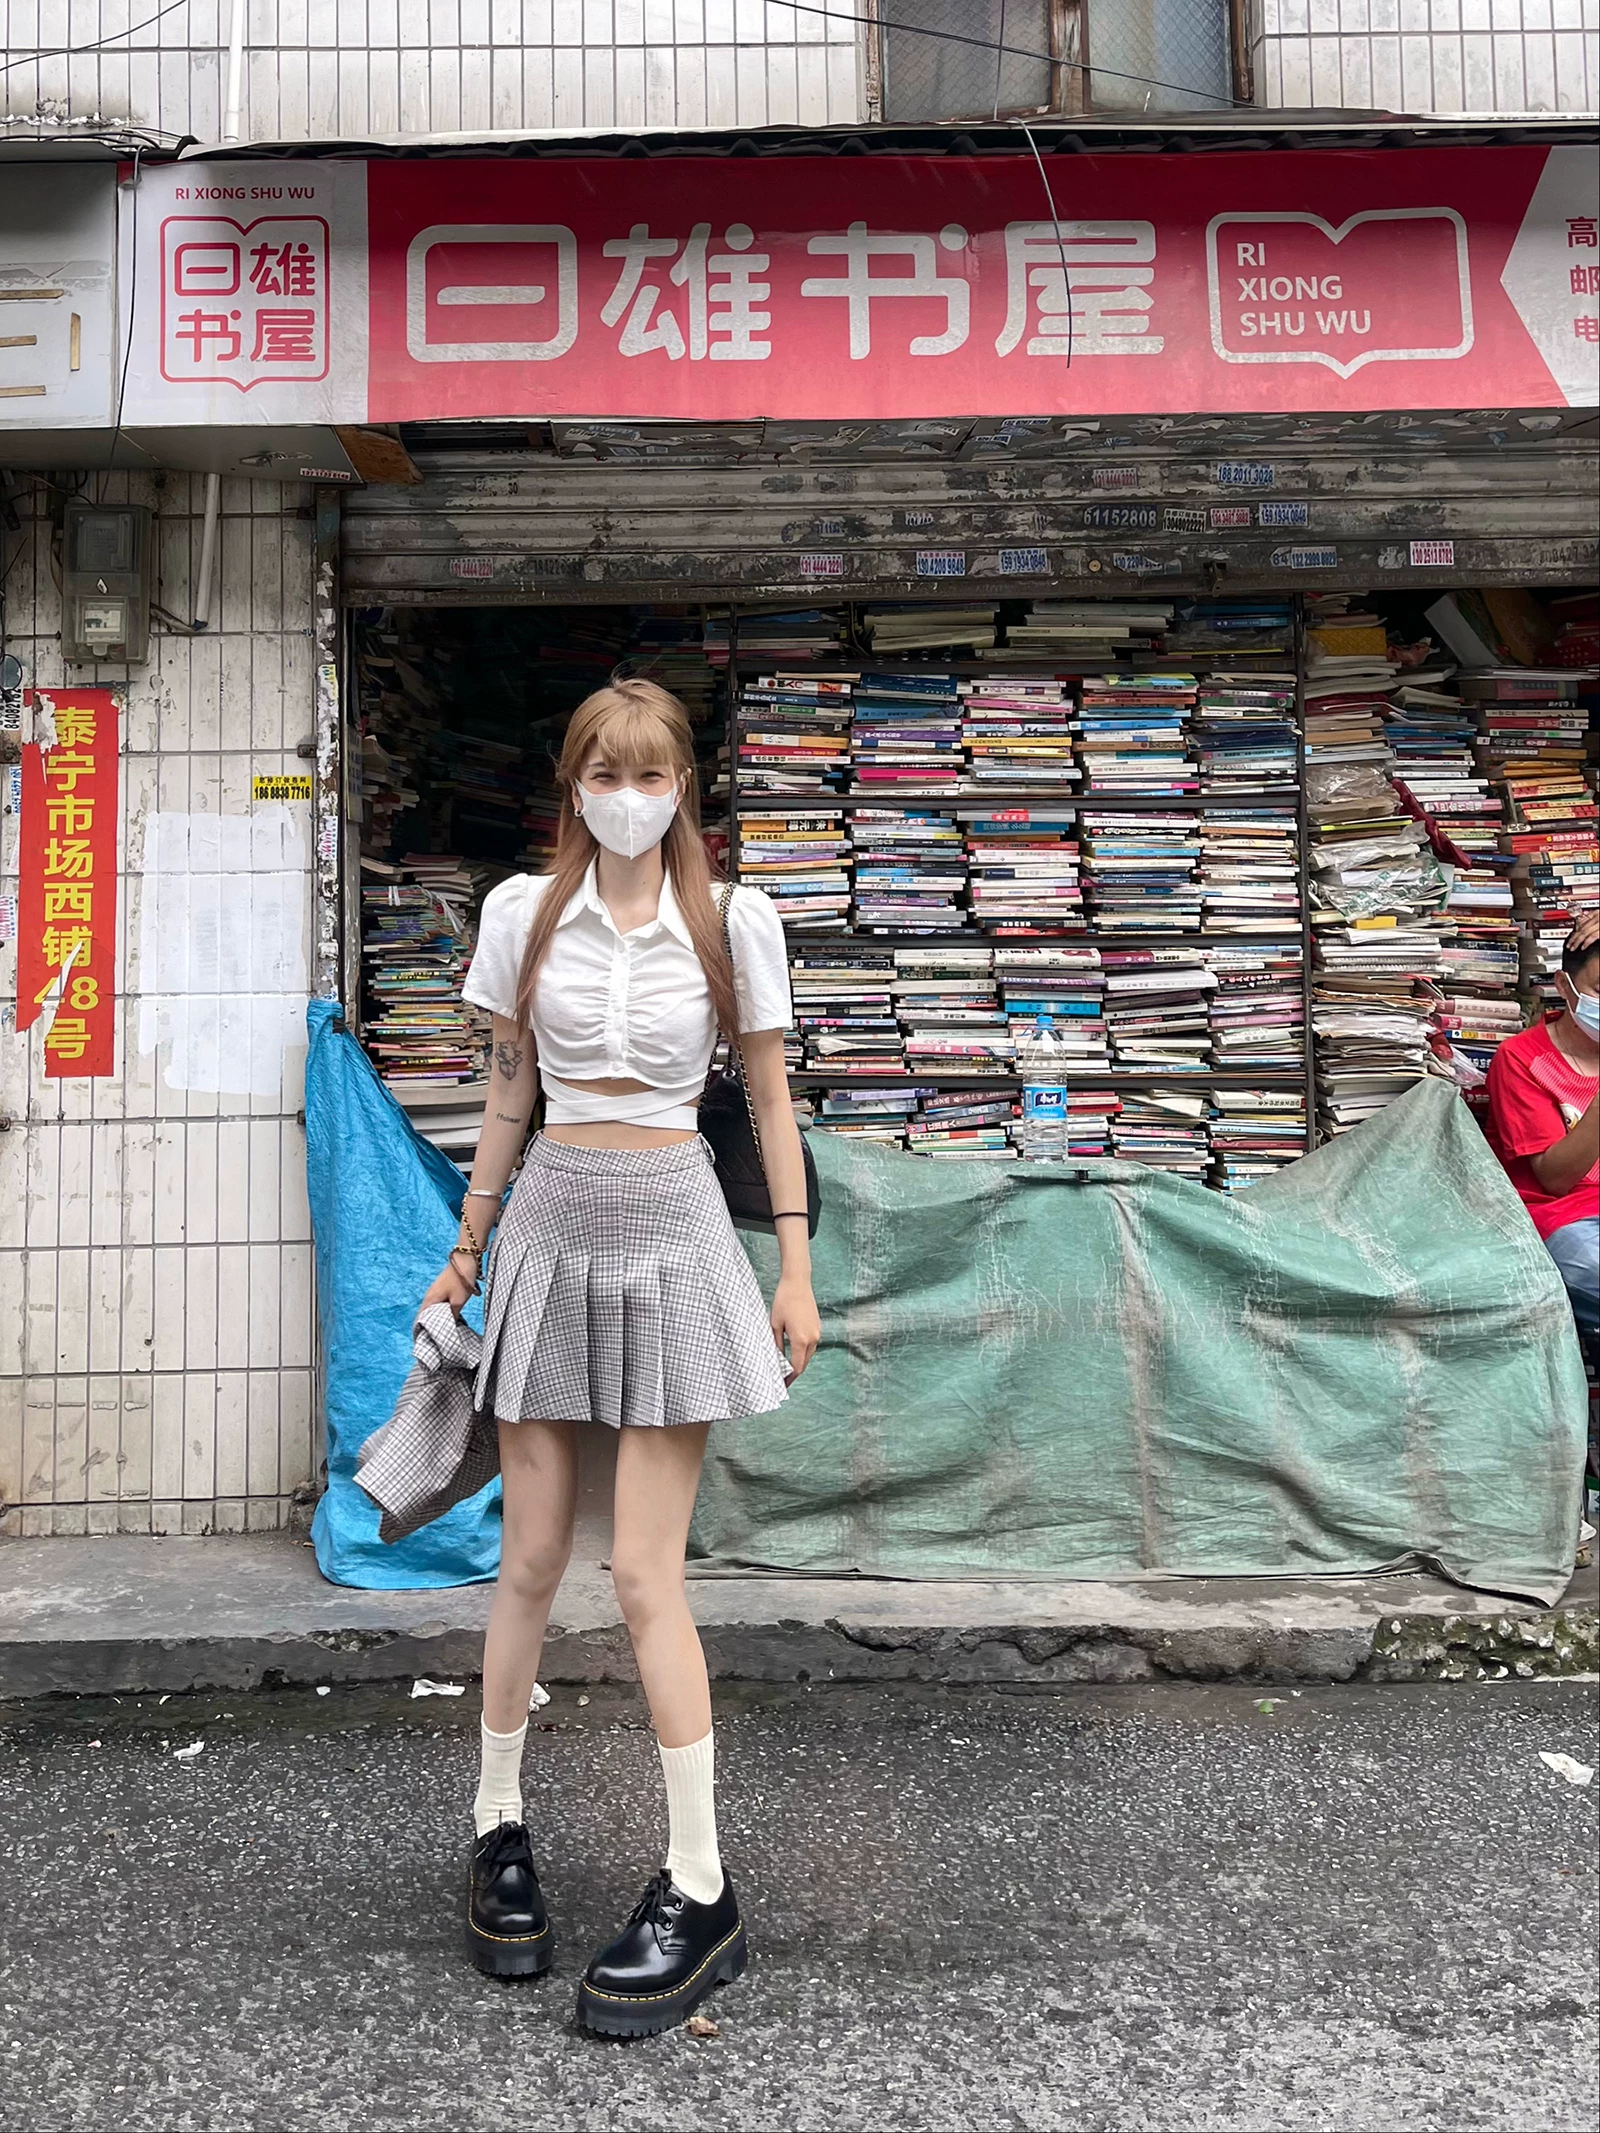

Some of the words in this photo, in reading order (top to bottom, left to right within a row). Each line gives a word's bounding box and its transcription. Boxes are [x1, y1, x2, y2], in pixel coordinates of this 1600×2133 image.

[175, 187, 190, 200] RI
[195, 187, 246, 200] XIONG
[250, 187, 283, 200] SHU
[287, 187, 315, 200] WU
[1565, 216, 1598, 248] 高
[1237, 243, 1265, 266] RI
[174, 242, 317, 297] 日雄
[405, 220, 1165, 362] 日雄书屋
[1237, 275, 1344, 301] XIONG
[174, 308, 317, 363] 书屋
[1240, 312, 1305, 337] SHU
[1317, 310, 1372, 335] WU
[1218, 467, 1232, 481] 188
[1233, 467, 1252, 482] 2011
[1254, 469, 1274, 483] 3028
[1083, 509, 1157, 527] 61152808
